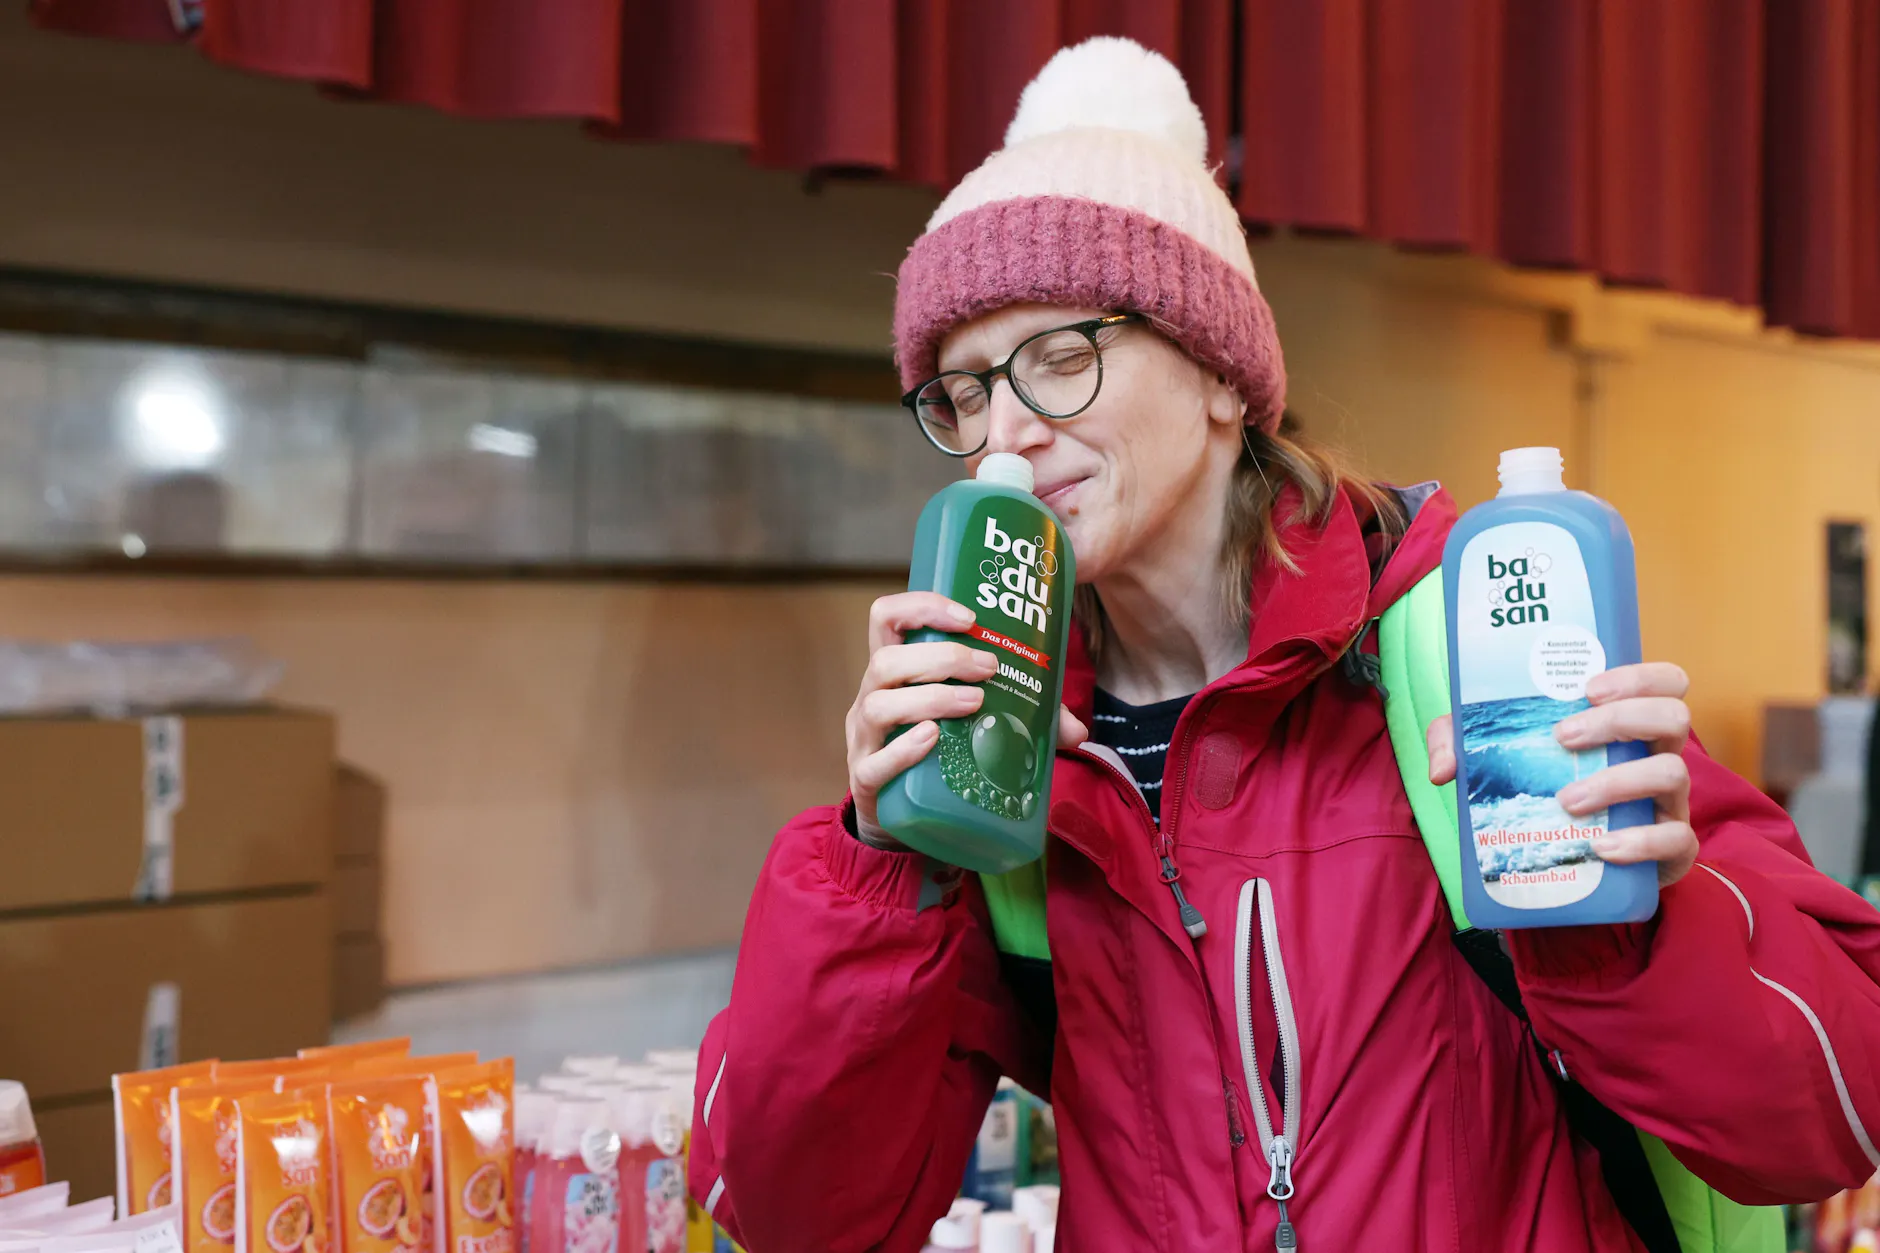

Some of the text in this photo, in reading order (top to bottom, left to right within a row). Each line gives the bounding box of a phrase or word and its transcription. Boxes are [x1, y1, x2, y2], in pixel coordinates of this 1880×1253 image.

[984, 515, 1037, 567] ba
[1487, 554, 1528, 580] ba
[1001, 562, 1049, 606] du
[1504, 578, 1546, 604] du
[1490, 603, 1549, 628] san
[981, 630, 1039, 662] Das Original
[1556, 682, 1578, 690] vegan
[1478, 825, 1602, 846] Wellenrauschen
[1501, 868, 1576, 885] Schaumbad
